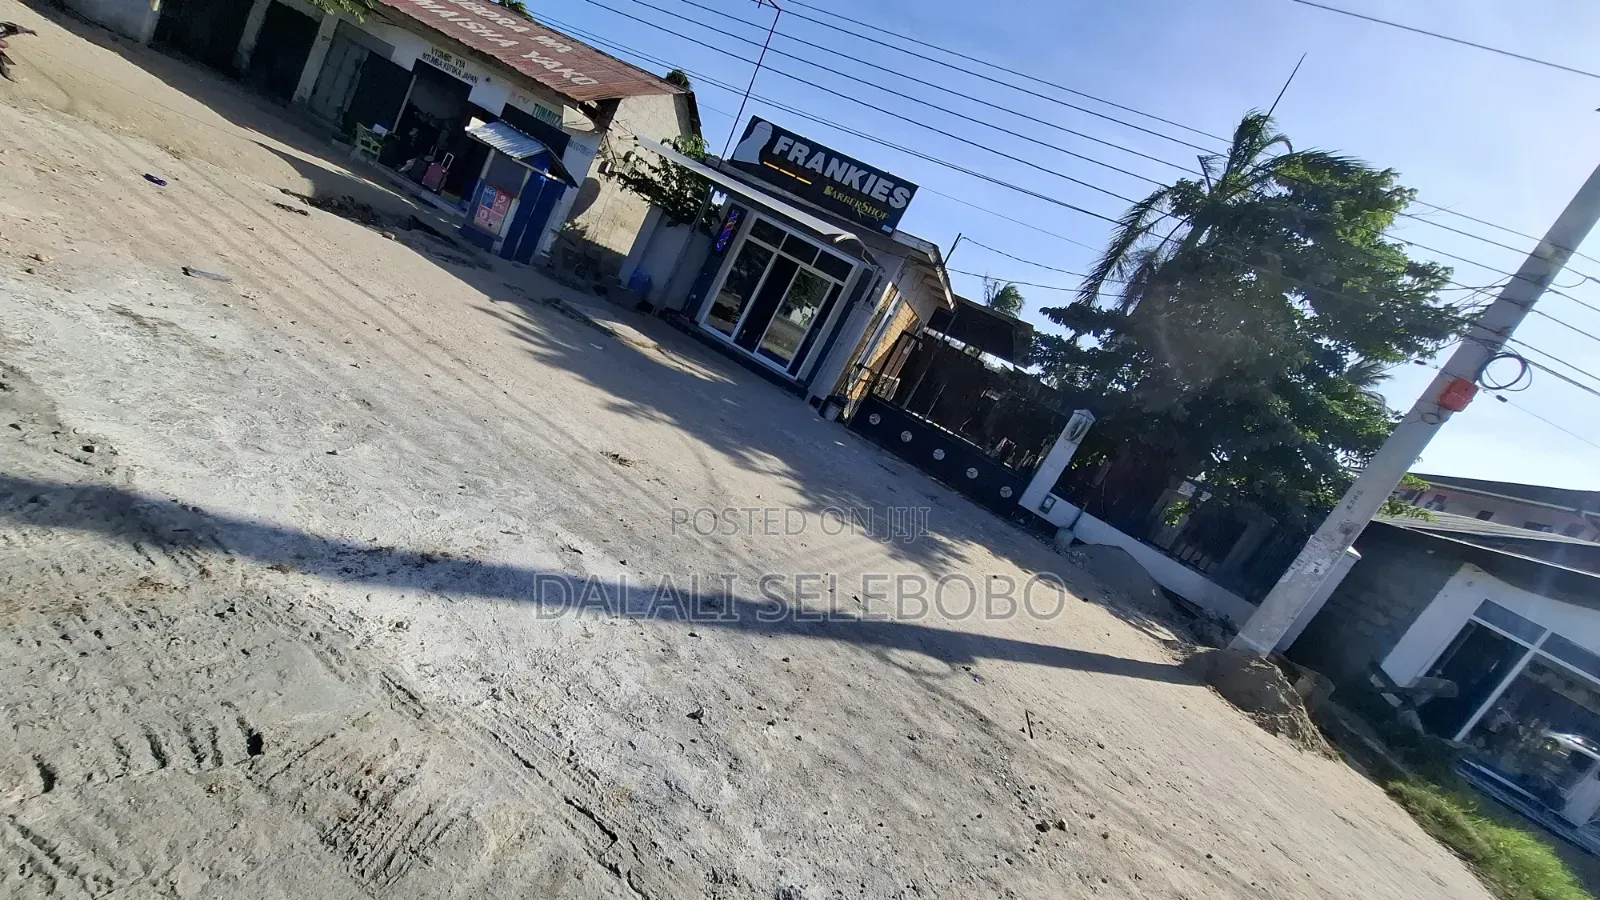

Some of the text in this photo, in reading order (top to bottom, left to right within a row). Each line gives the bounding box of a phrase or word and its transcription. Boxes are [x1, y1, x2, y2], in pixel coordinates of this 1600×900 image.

[421, 52, 443, 67] MTUMBA
[461, 71, 479, 85] JAPAN
[520, 50, 599, 86] YAKO
[772, 135, 911, 209] FRANKIES
